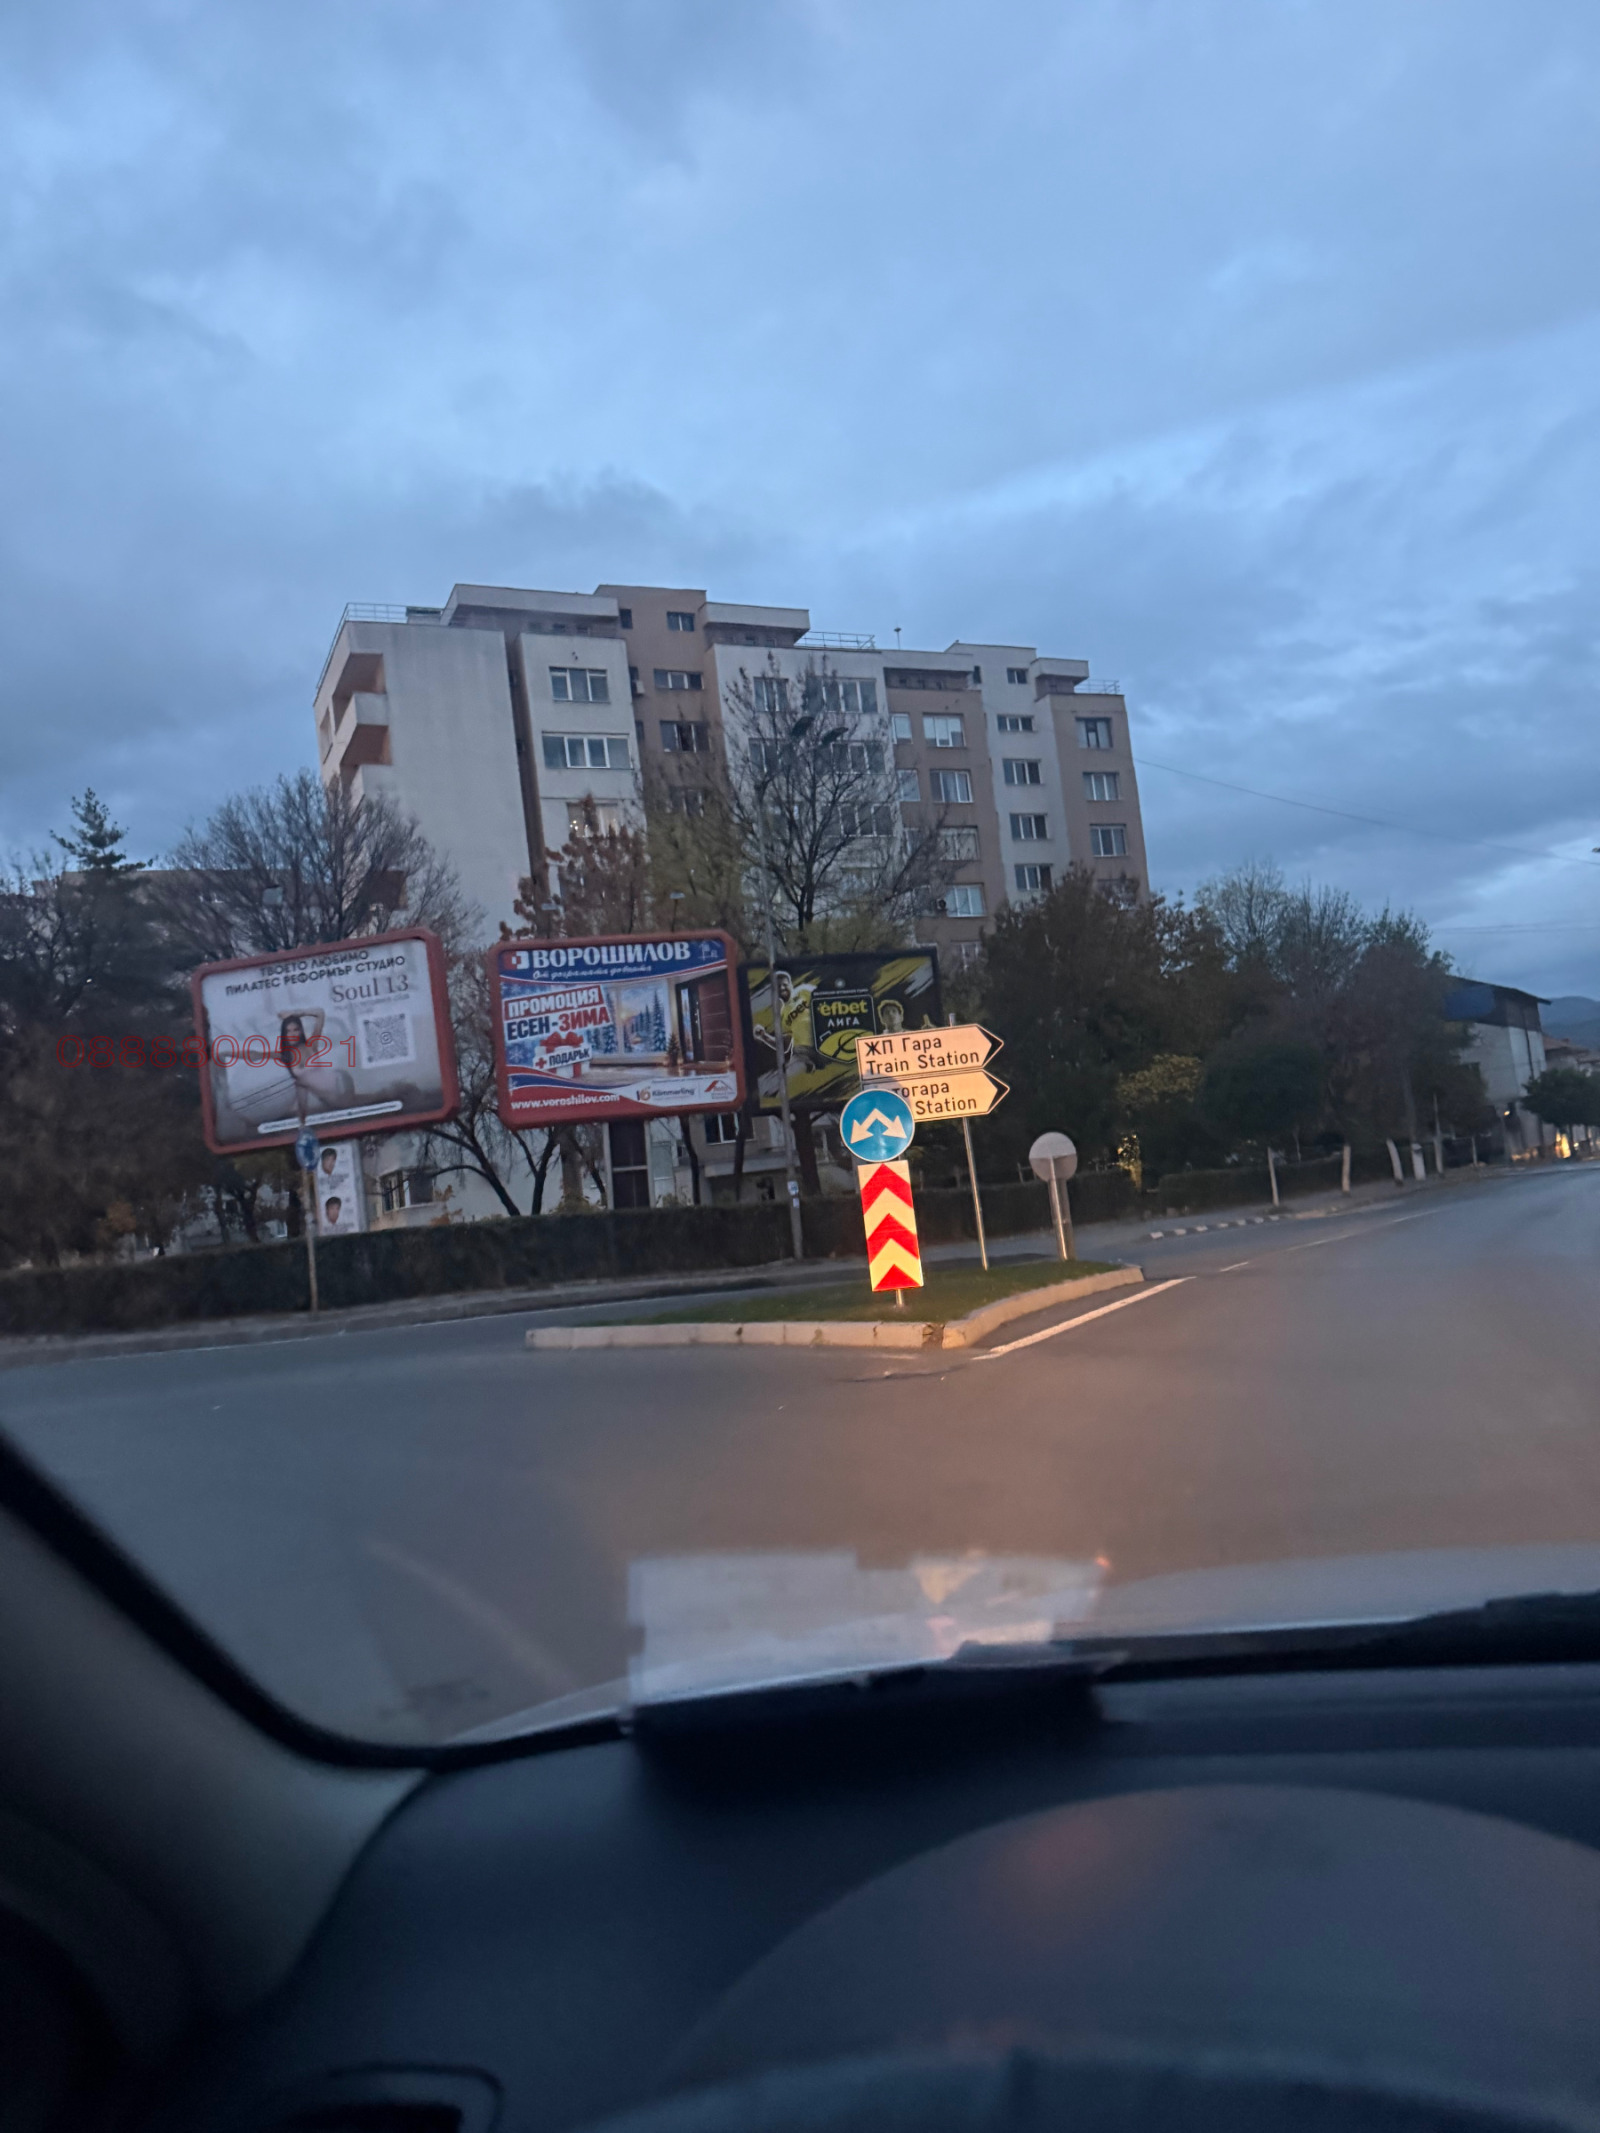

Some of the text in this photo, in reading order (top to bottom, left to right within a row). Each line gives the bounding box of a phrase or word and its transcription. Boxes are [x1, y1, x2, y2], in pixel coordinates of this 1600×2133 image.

[532, 941, 692, 968] ВОРОШИЛОВ
[225, 955, 406, 996] ПИЛАТЕС РЕФОРМЪР СТУДИО
[260, 959, 308, 977] ТВОЕТО
[332, 974, 410, 1003] Soul 13
[508, 988, 600, 1018] ПРОМОЦИЯ
[819, 1000, 868, 1016] efbet
[864, 1037, 942, 1057] ЖП Гара
[866, 1050, 980, 1075] Train Station
[511, 1093, 620, 1110] www.voroshilov.com
[915, 1097, 977, 1115] Station
